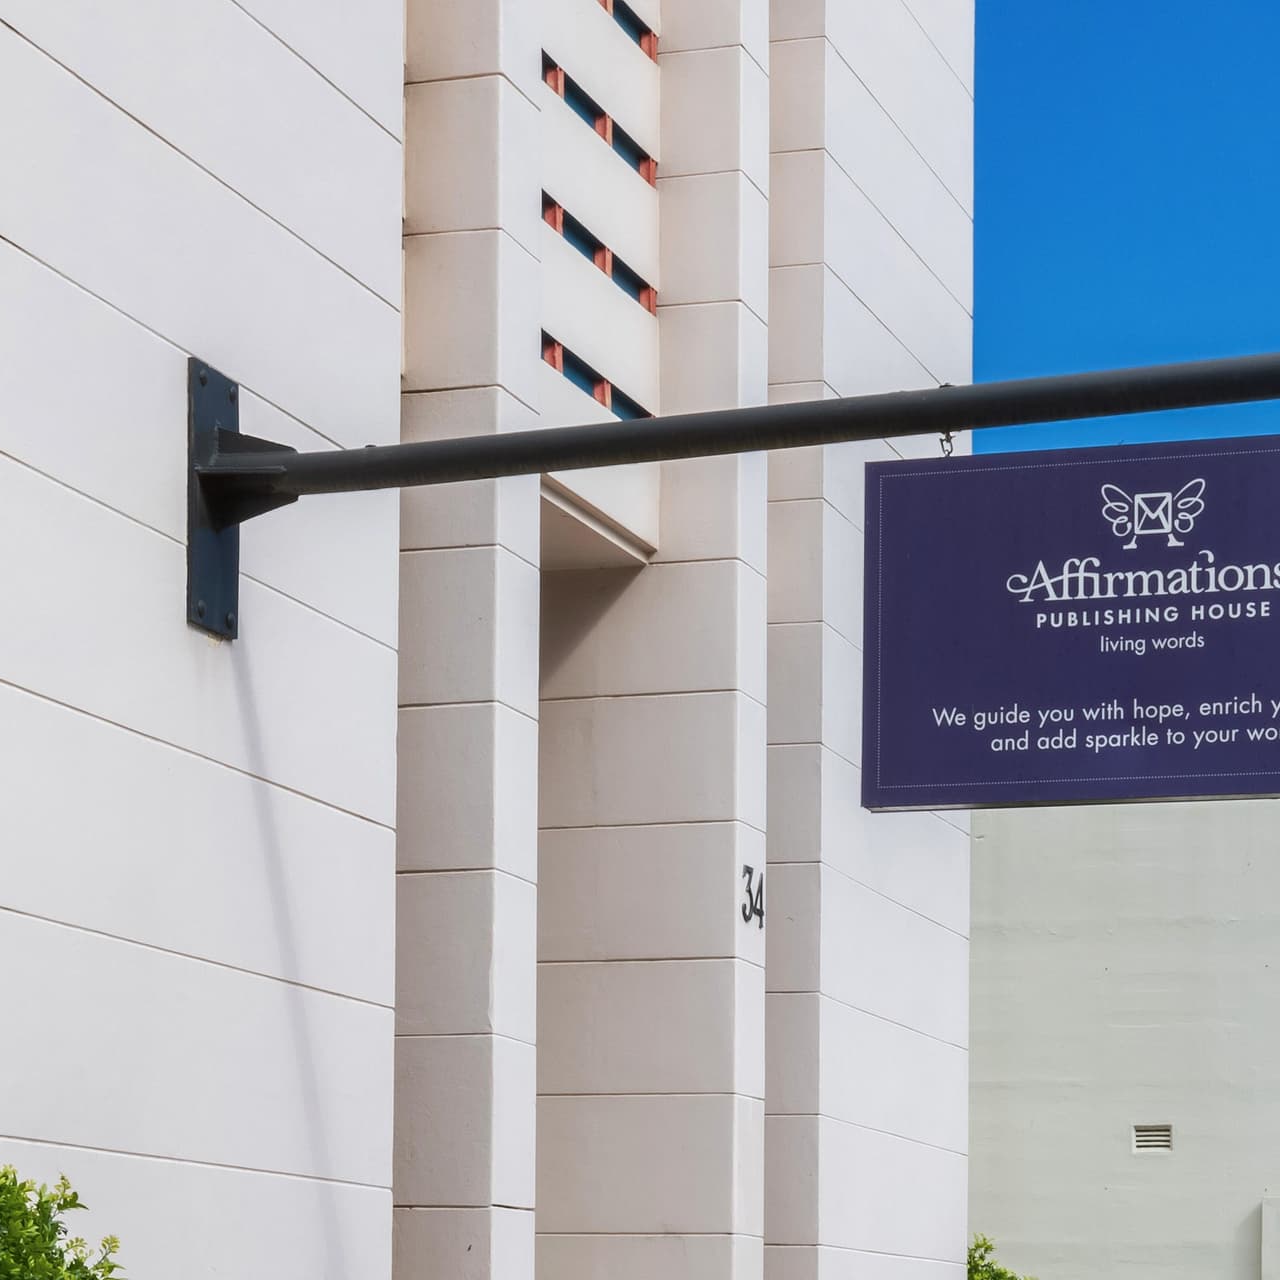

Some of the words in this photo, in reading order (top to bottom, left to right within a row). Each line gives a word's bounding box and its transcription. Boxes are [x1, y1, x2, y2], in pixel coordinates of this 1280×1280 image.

[1036, 606, 1179, 628] PUBLISHING
[1191, 602, 1271, 620] HOUSE
[1100, 636, 1146, 656] living
[1152, 631, 1205, 650] words
[932, 707, 966, 727] We
[973, 703, 1030, 731] guide
[1038, 708, 1074, 728] you
[1082, 699, 1124, 721] with
[1133, 698, 1190, 724] hope,
[1199, 692, 1263, 716] enrich
[991, 729, 1029, 751] and
[1037, 728, 1077, 750] add
[1085, 725, 1160, 753] sparkle
[1166, 728, 1185, 745] to
[1193, 728, 1239, 750] your
[741, 864, 764, 930] 34
